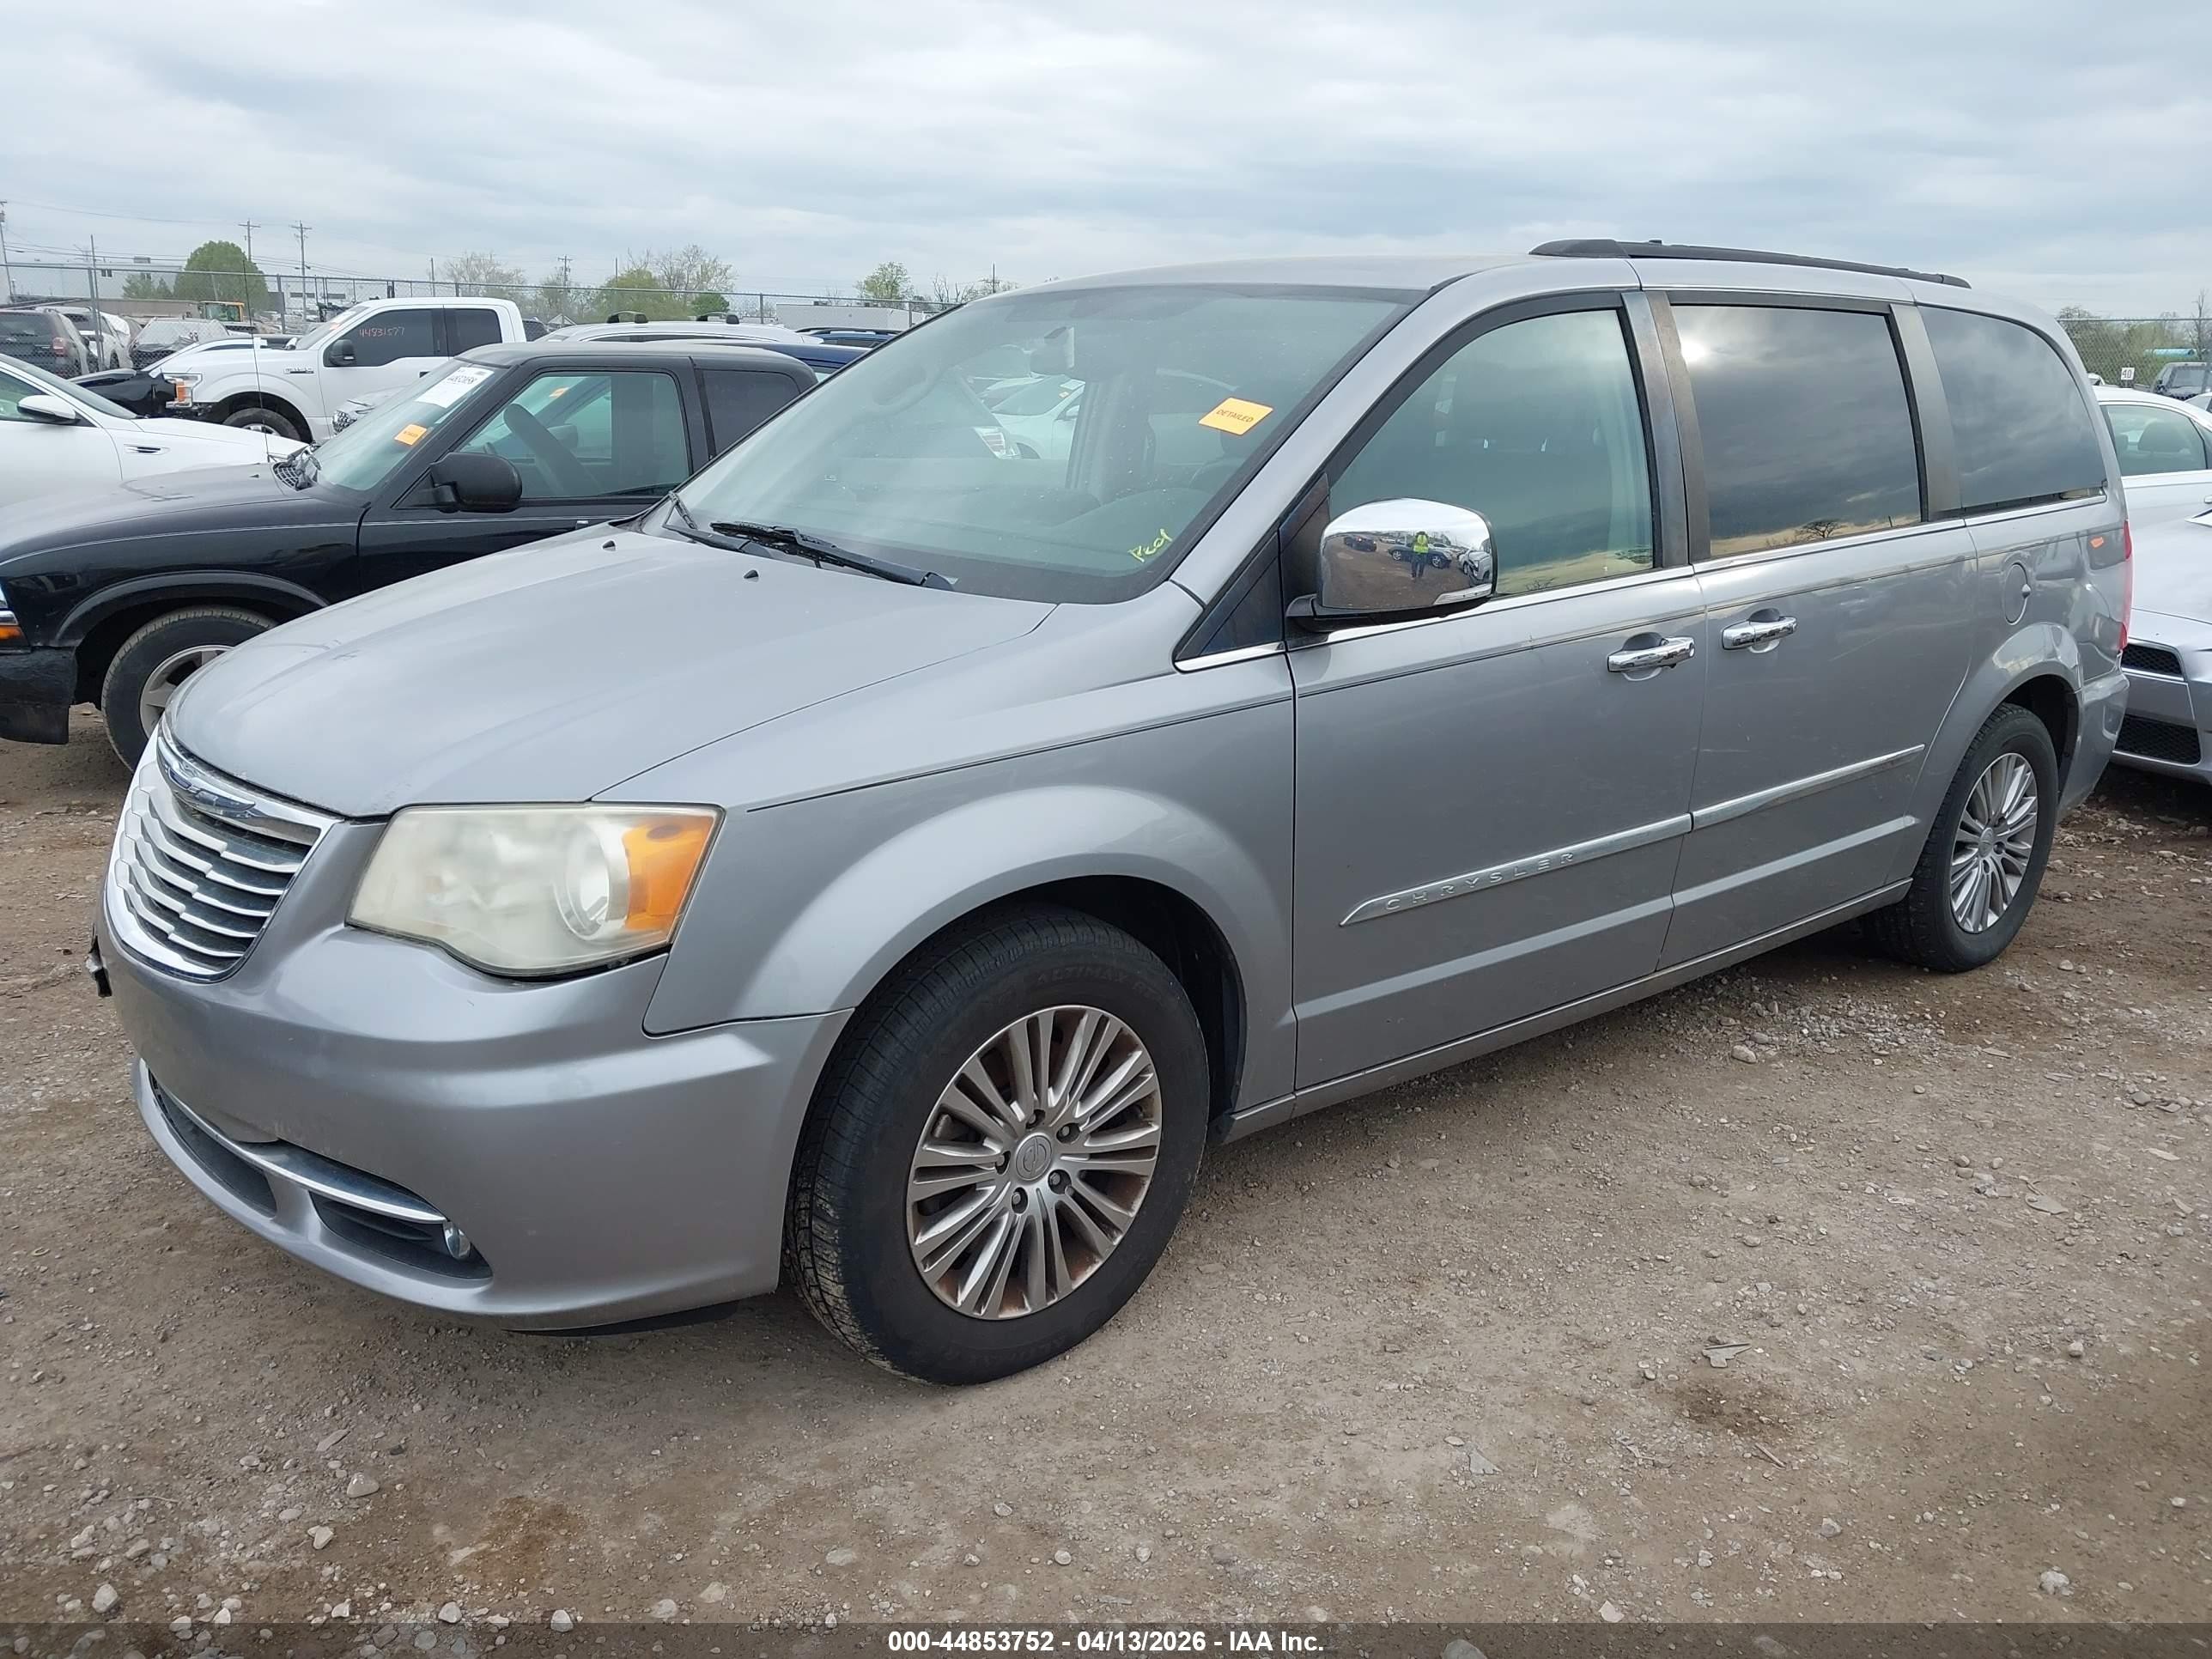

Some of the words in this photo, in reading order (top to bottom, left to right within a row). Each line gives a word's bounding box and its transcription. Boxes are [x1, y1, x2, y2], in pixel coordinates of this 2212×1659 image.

[2122, 369, 2132, 379] 40
[1216, 409, 1255, 423] DETAILED
[1384, 852, 1575, 911] CHRYSLER
